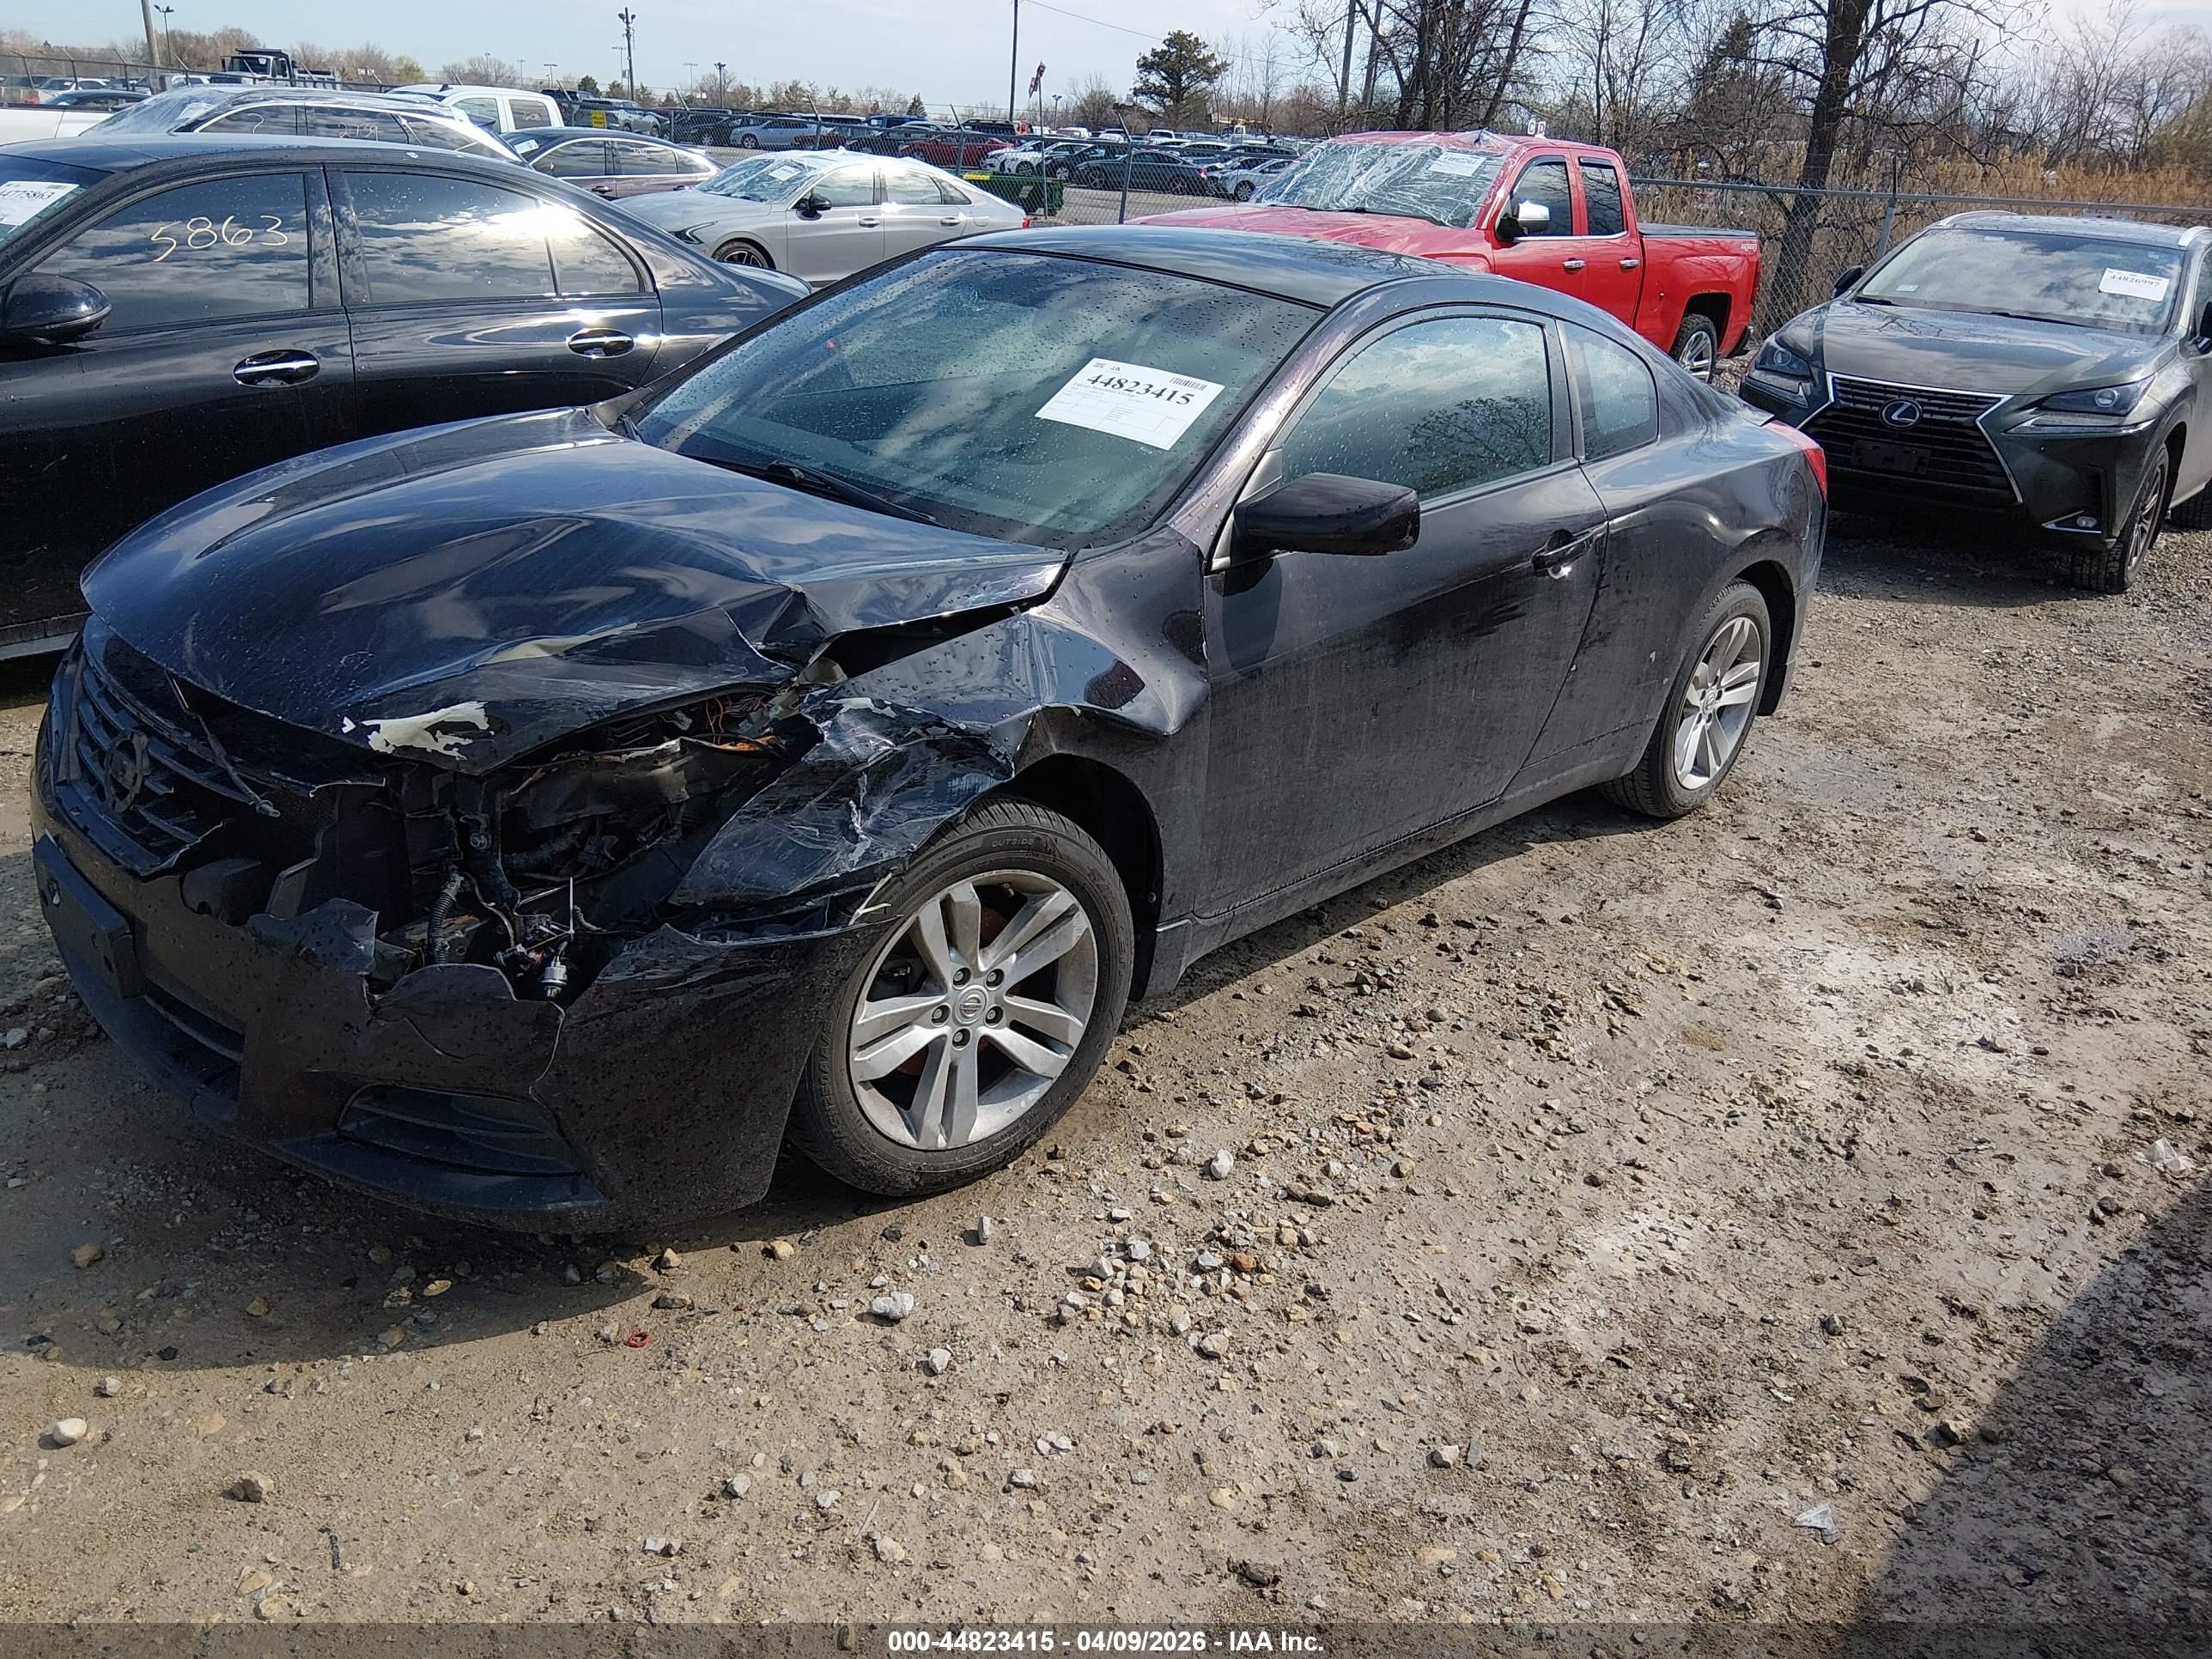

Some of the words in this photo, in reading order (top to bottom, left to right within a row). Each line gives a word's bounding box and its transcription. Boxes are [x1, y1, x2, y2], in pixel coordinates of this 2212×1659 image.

[149, 215, 289, 263] 5863
[1086, 373, 1196, 406] 44823415
[990, 836, 1035, 848] OUTSIDE
